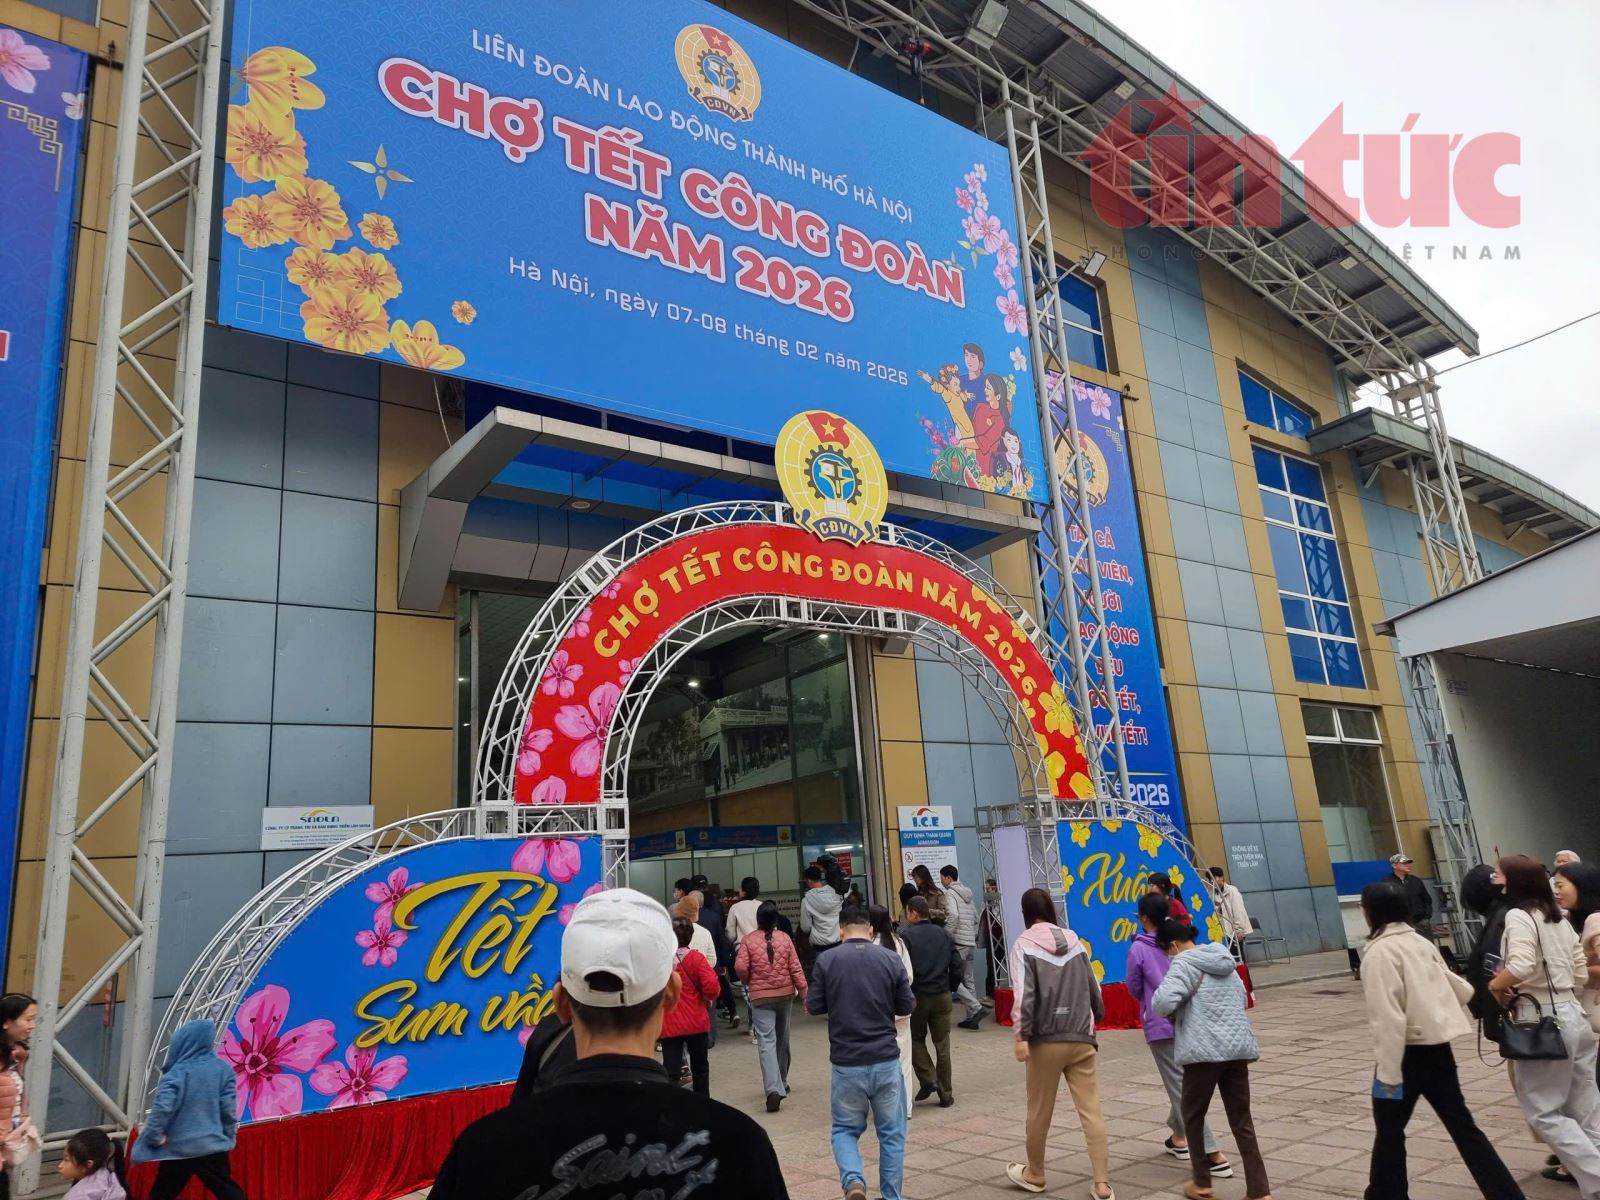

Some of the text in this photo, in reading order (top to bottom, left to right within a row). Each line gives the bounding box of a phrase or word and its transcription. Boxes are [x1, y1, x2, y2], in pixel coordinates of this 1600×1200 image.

[472, 29, 912, 224] LIÊN ĐOÀN LAO ĐỘNG THÀNH PHỐ HÀ NỘI
[378, 57, 966, 308] CHỢ TẾT CÔNG ĐOÀN
[584, 193, 855, 322] NĂM 2026
[509, 257, 908, 386] Hà Nội, ngày 07-08 tháng 02 năm 2026
[820, 520, 858, 539] CĐVN
[1094, 526, 1115, 549] CẢ
[1097, 560, 1134, 586] VIÊN,
[594, 541, 1038, 695] CHỢ TẾT CÔNG ĐOÀN NĂM 2026
[393, 871, 559, 982] Tết
[1078, 852, 1154, 907] Xuâ
[355, 980, 469, 1048] Sum
